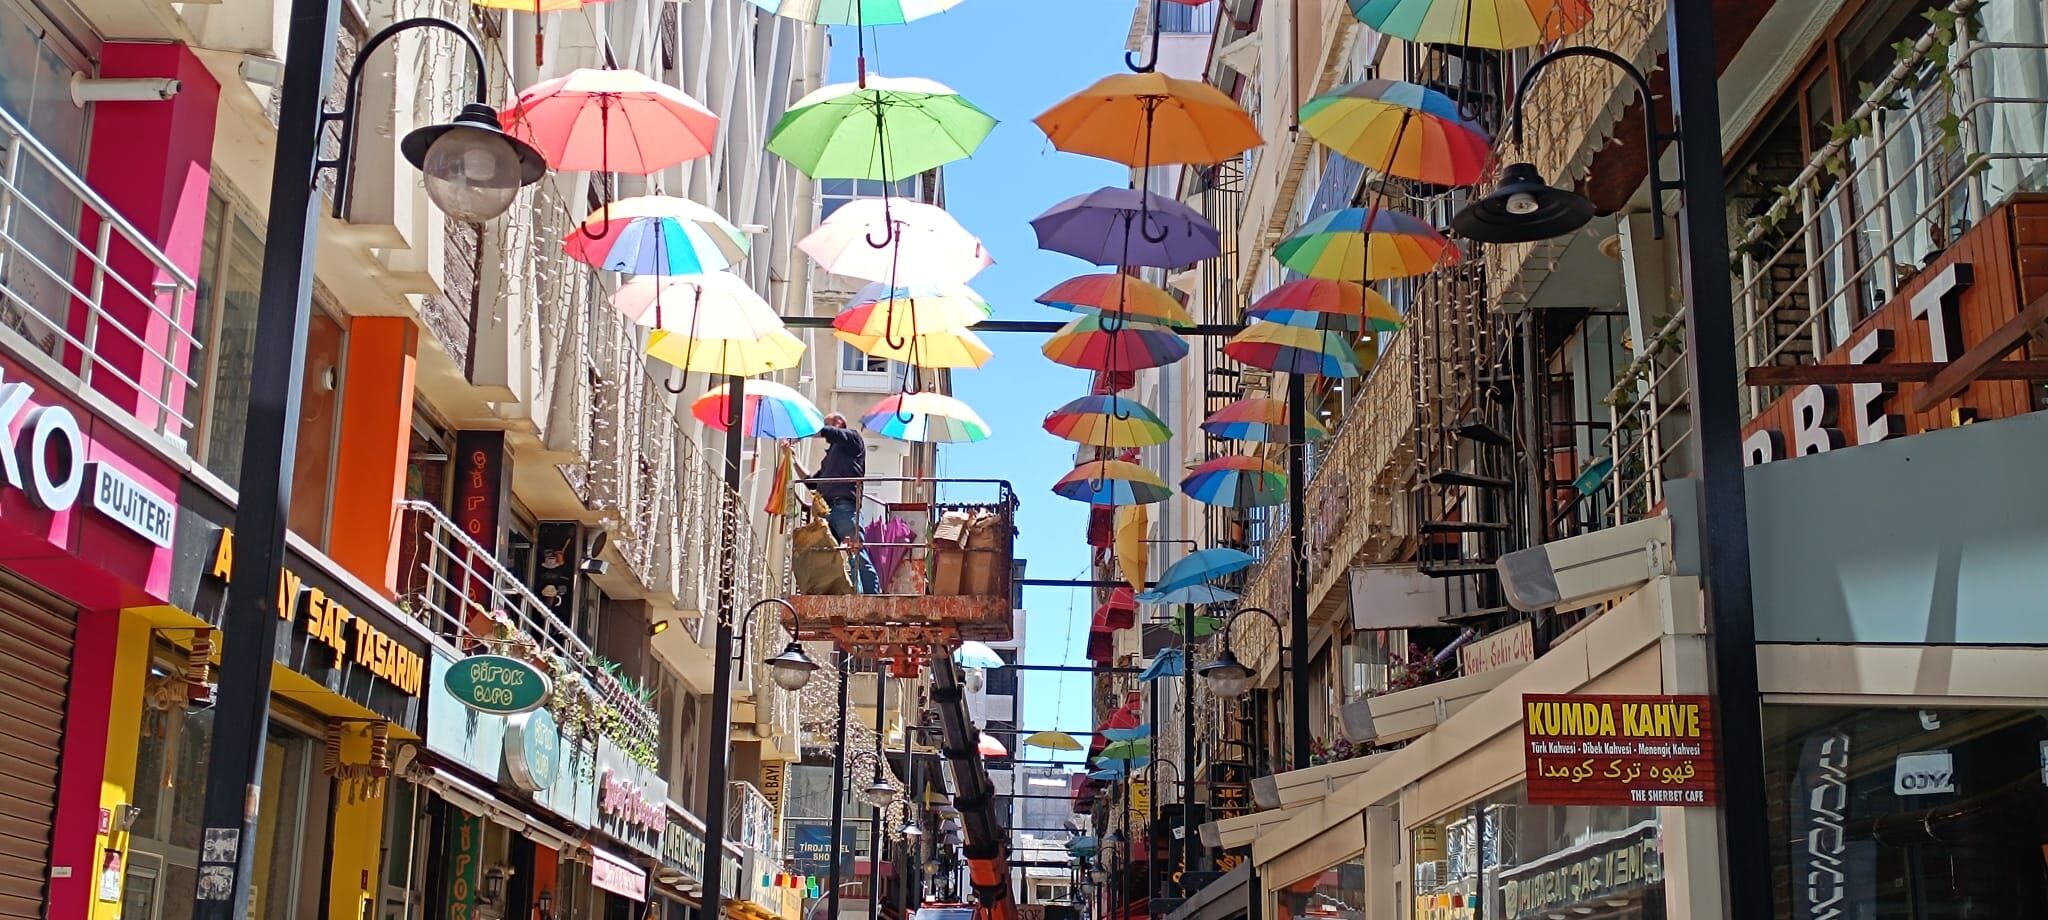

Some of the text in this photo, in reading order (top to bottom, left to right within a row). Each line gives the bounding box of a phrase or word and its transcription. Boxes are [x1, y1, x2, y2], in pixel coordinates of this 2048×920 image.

[308, 587, 350, 670] SAÇ
[356, 616, 424, 698] TASARIM
[1528, 702, 1700, 737] KUMDA KAHVE
[1531, 742, 1547, 754] Türk
[1549, 742, 1576, 754] Kahvesi
[1604, 743, 1632, 755] Kahvesi
[1638, 743, 1671, 758] Menengiç
[1672, 744, 1700, 756] Kahvesi
[1650, 760, 1695, 784] قهوه
[1631, 790, 1704, 802] THE SHERBET CAFE
